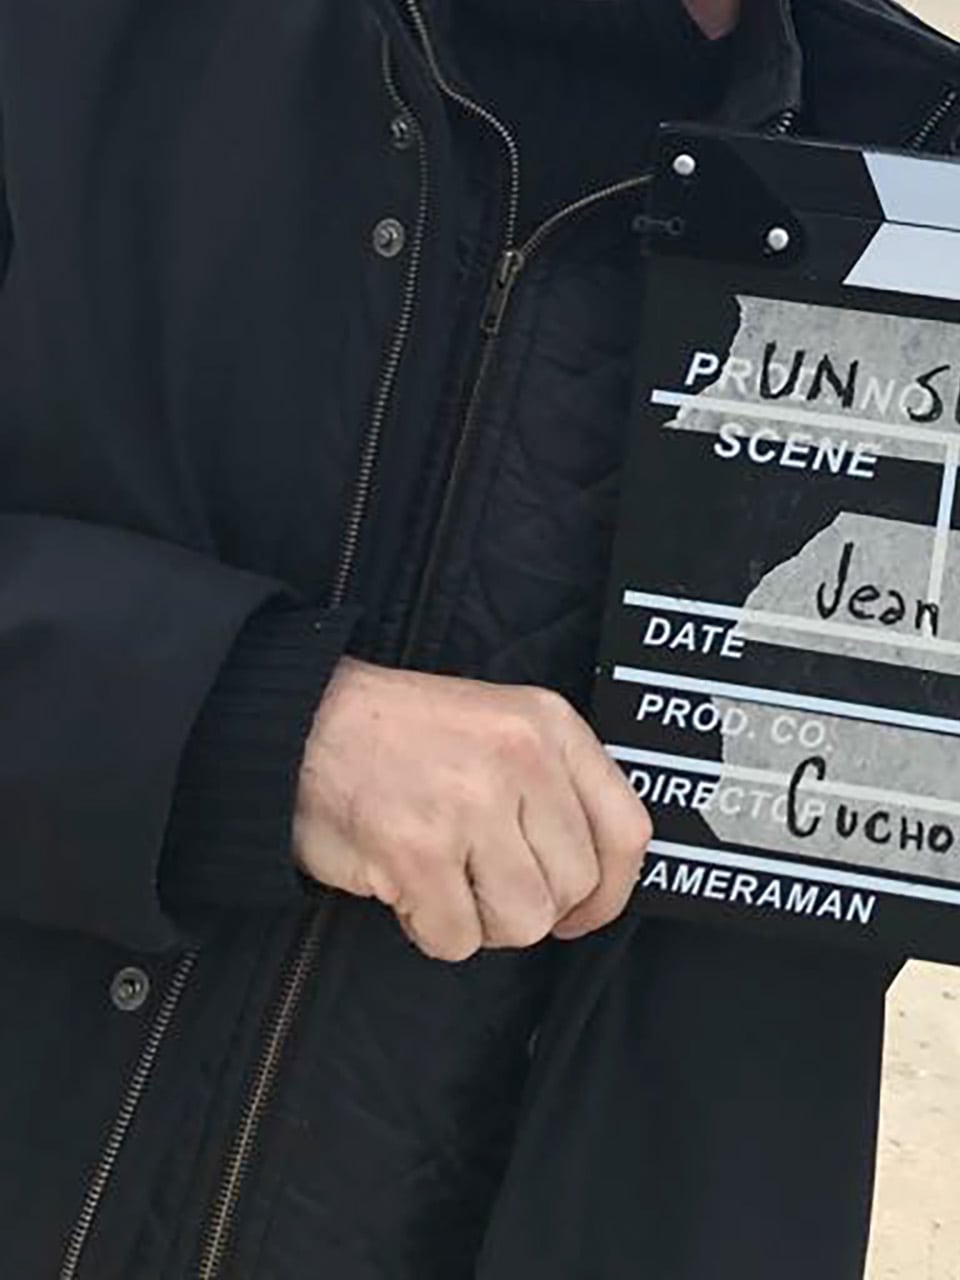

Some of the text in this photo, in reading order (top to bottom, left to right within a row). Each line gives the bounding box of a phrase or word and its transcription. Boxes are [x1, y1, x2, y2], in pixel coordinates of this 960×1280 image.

[760, 340, 859, 409] UN
[713, 422, 881, 478] SCENE
[816, 541, 939, 637] Jean
[642, 616, 746, 659] DATE
[636, 693, 834, 754] PROD. CO.
[642, 860, 876, 924] AMERAMAN
